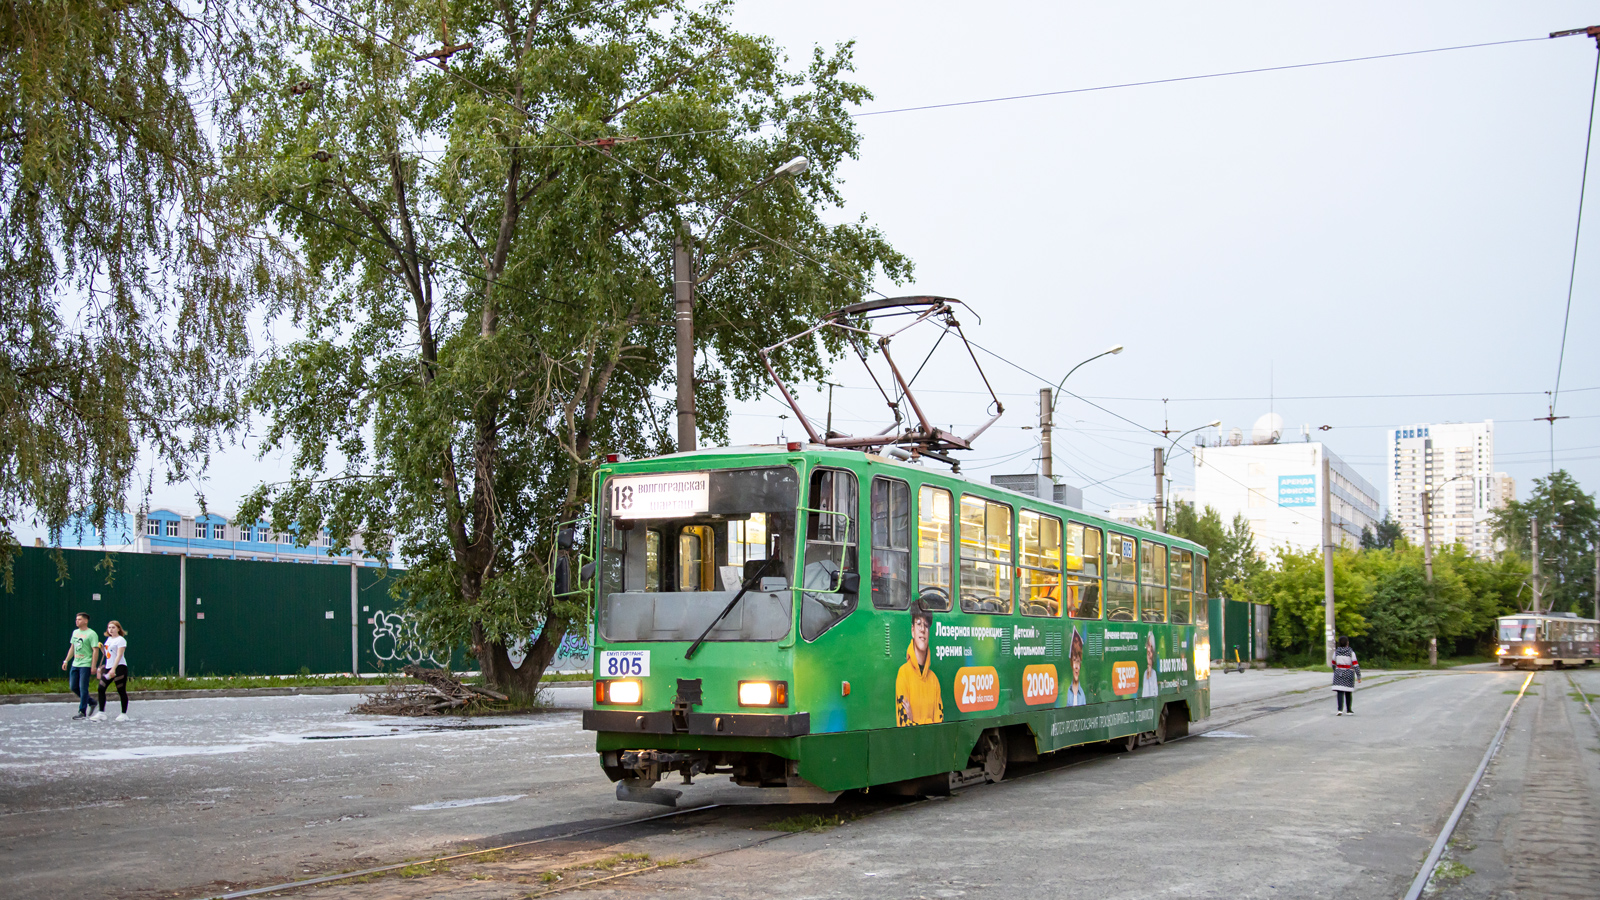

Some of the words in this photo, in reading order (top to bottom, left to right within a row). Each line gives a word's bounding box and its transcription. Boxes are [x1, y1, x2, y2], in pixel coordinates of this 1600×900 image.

[614, 485, 633, 510] 18
[1280, 487, 1315, 495] ОФИСОВ
[935, 622, 970, 640] Лазерная
[971, 627, 1003, 641] коррекция
[1014, 624, 1035, 640] Детский
[935, 646, 962, 661] зрения
[1014, 643, 1046, 659] офтальмолог
[608, 657, 642, 675] 805
